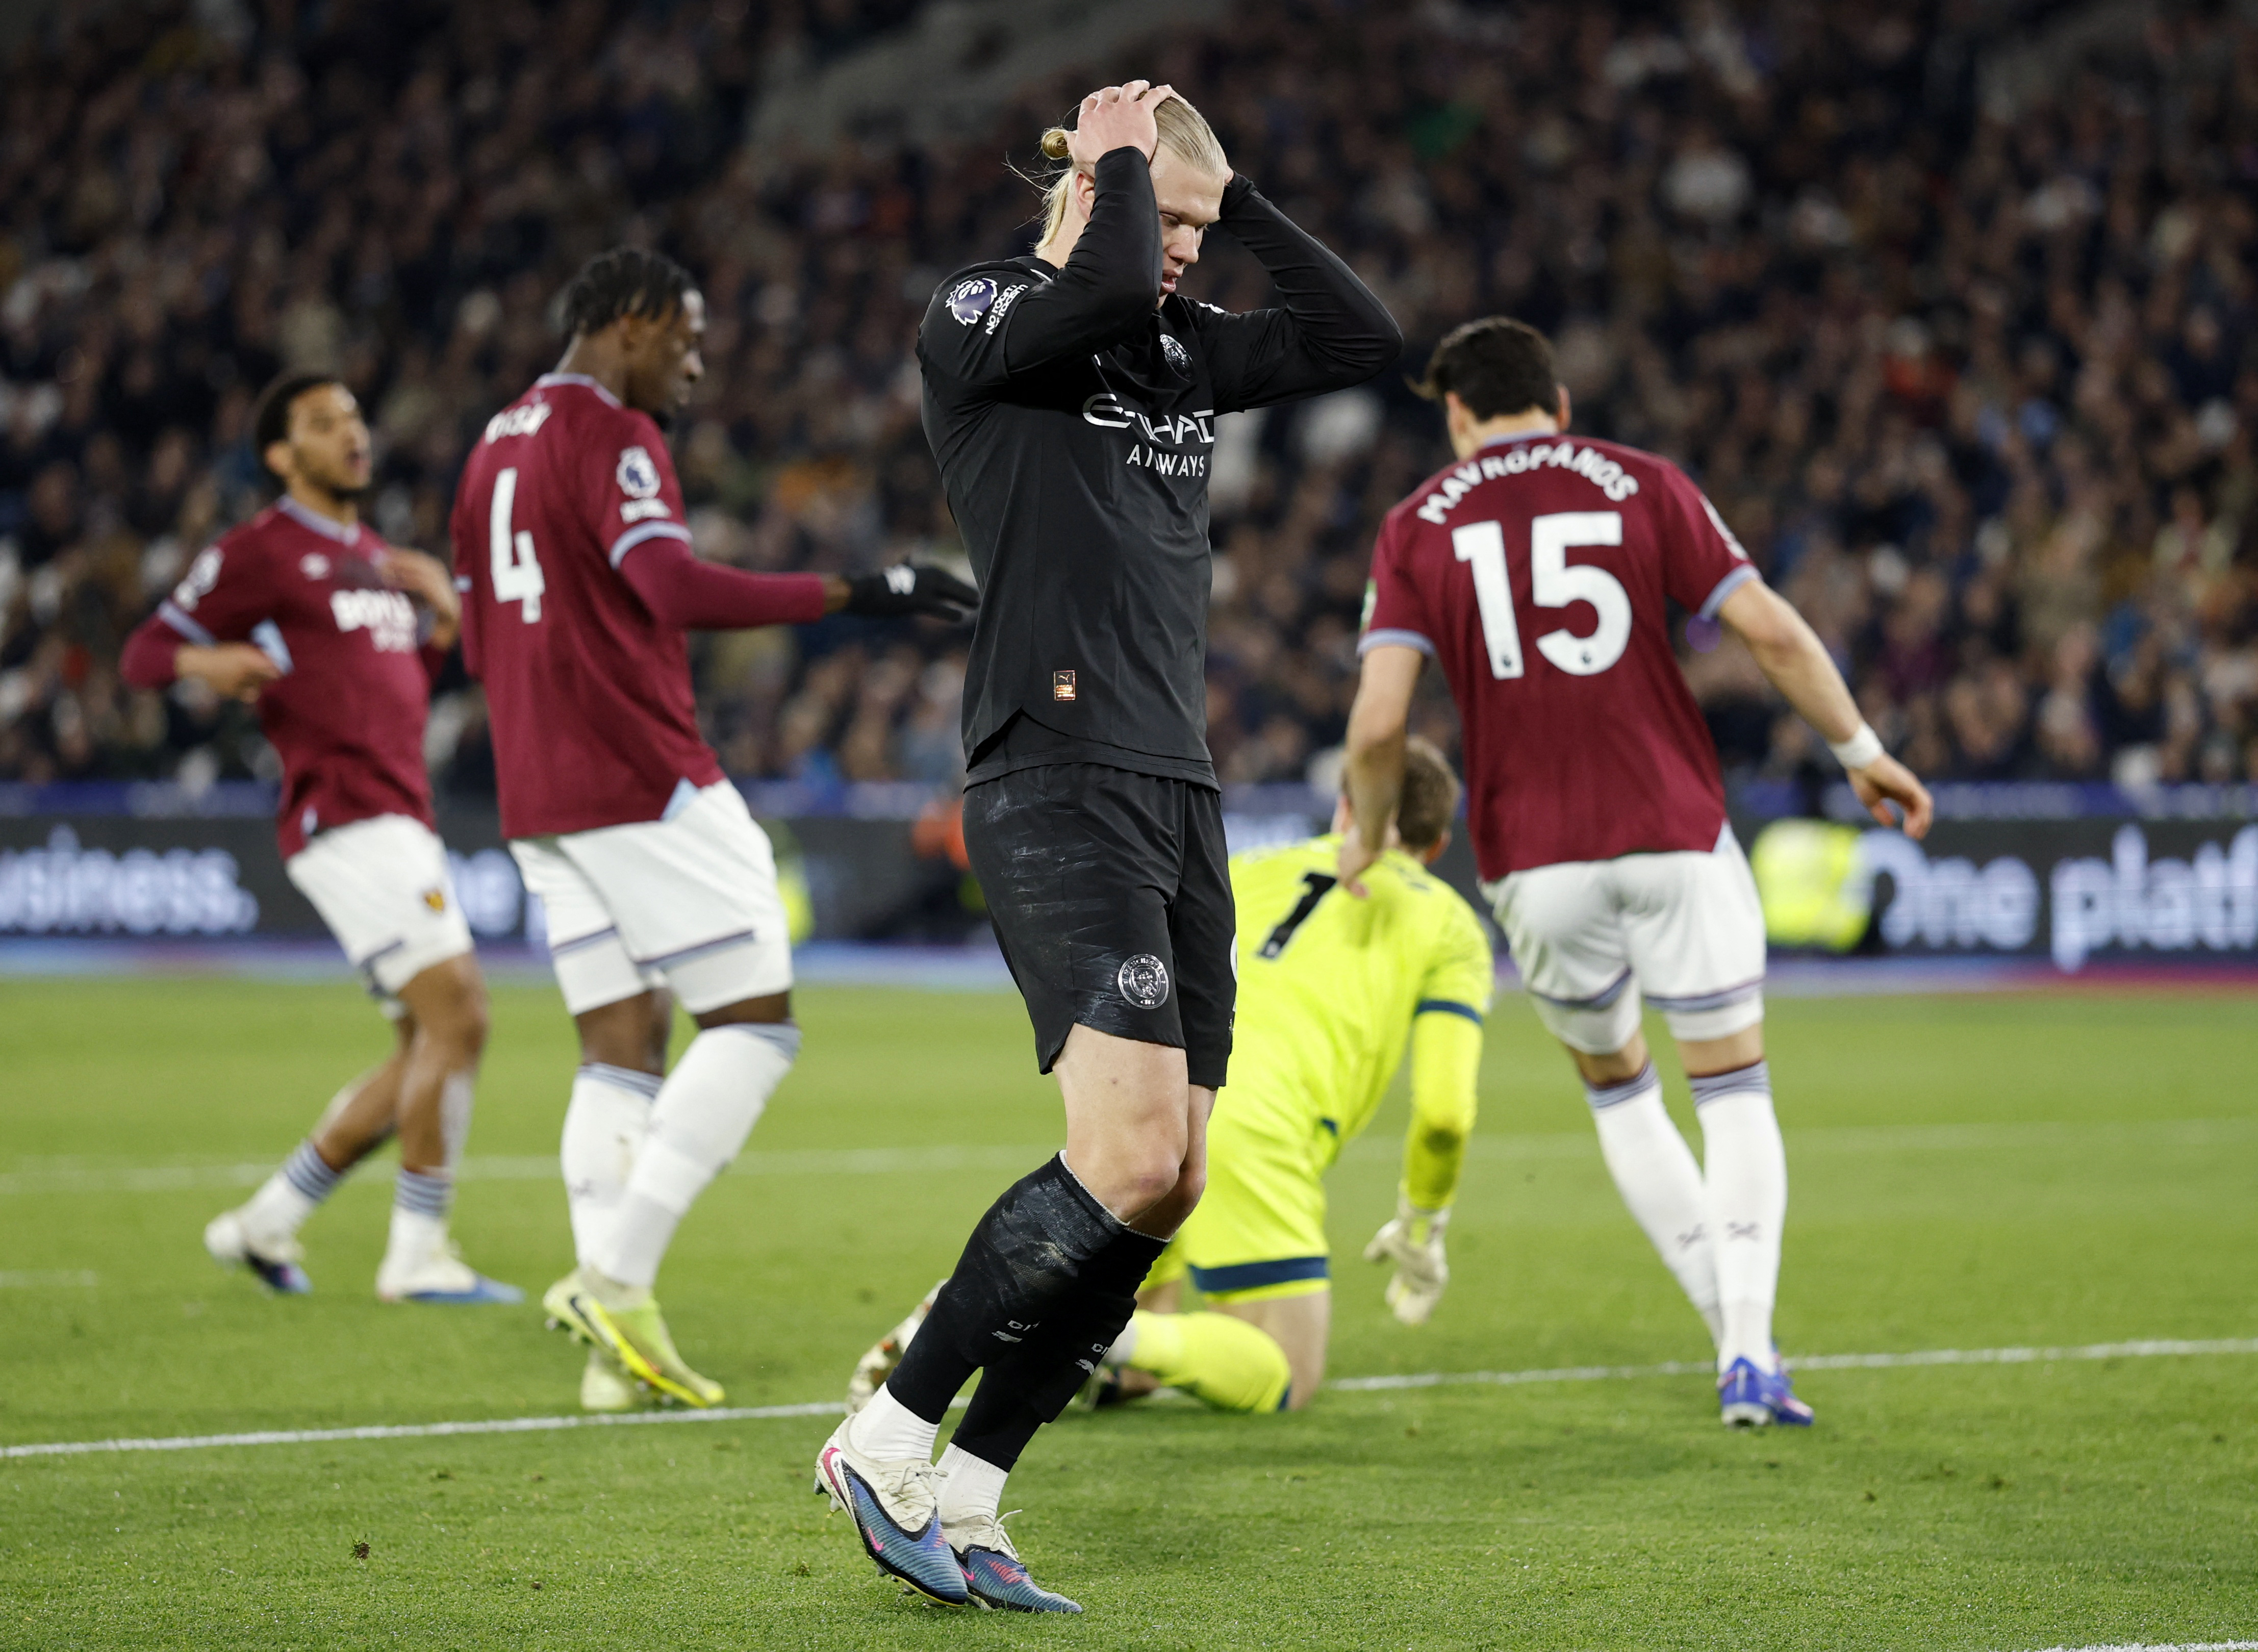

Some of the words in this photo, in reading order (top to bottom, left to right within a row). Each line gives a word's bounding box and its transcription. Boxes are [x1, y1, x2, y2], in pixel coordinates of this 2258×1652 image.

[985, 315, 996, 335] No
[1126, 444, 1204, 477] AIWAYS
[1417, 441, 1639, 525] MAVROPANOS
[490, 466, 545, 624] 4
[1451, 511, 1632, 680] 15
[1257, 872, 1338, 959] 1
